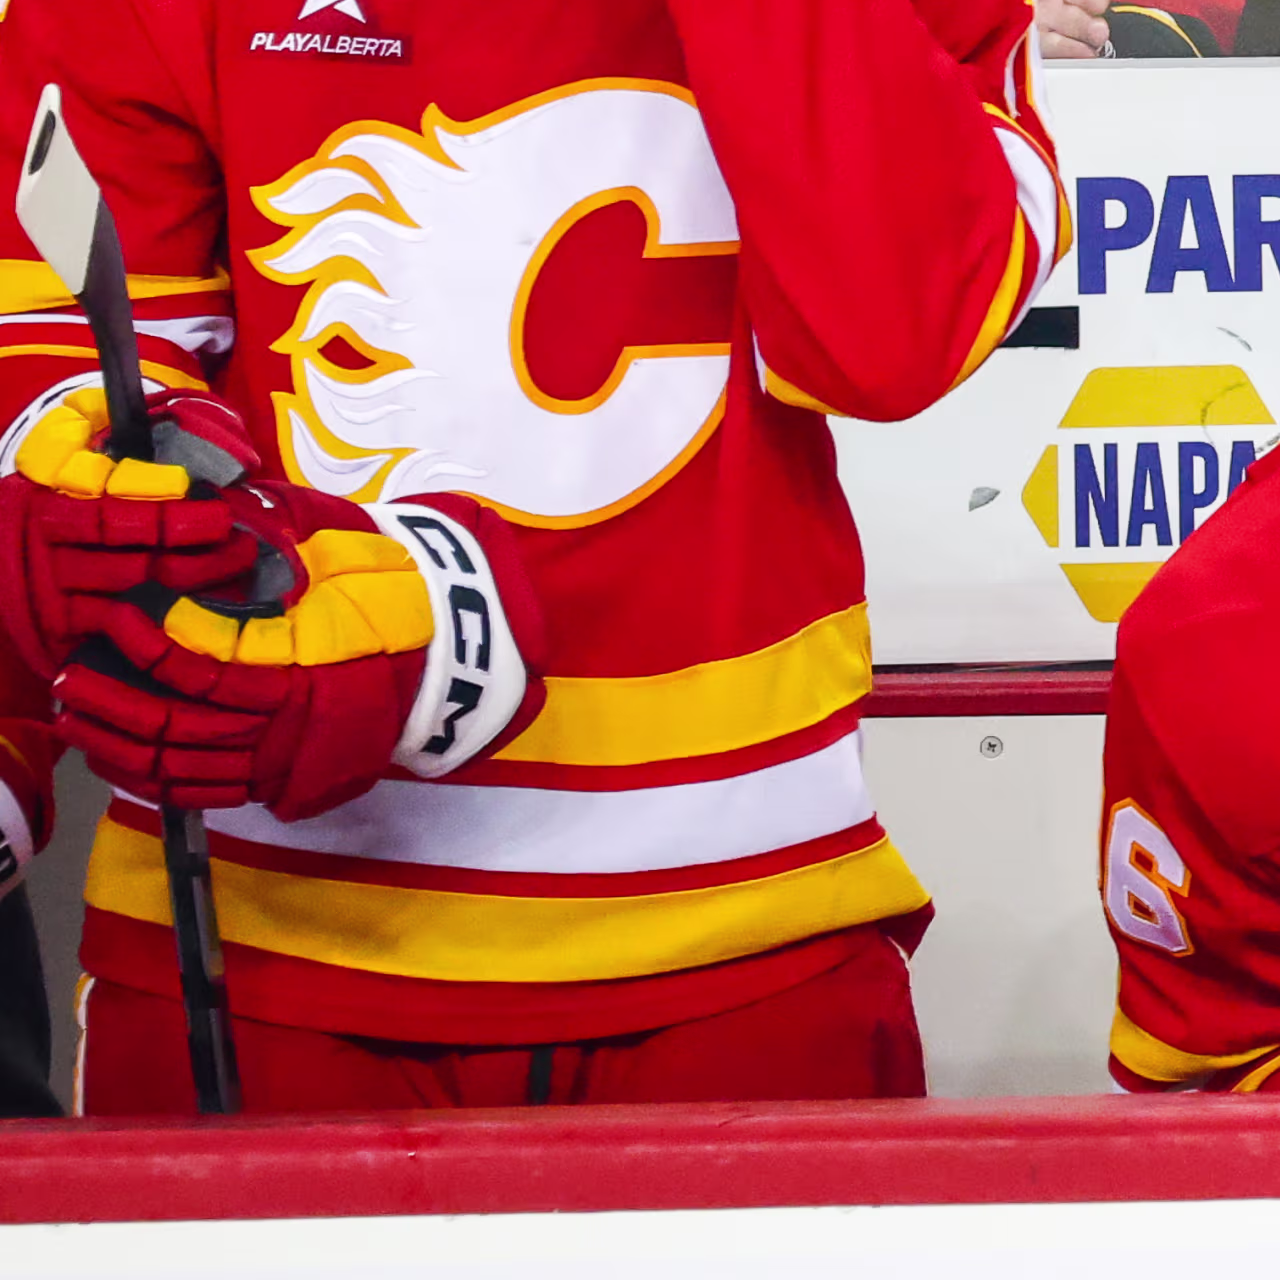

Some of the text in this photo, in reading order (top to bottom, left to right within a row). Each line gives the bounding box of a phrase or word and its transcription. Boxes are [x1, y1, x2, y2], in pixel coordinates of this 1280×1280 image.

[250, 32, 402, 58] PLAYALBERTA
[396, 514, 491, 756] CCM
[1103, 797, 1195, 958] 6
